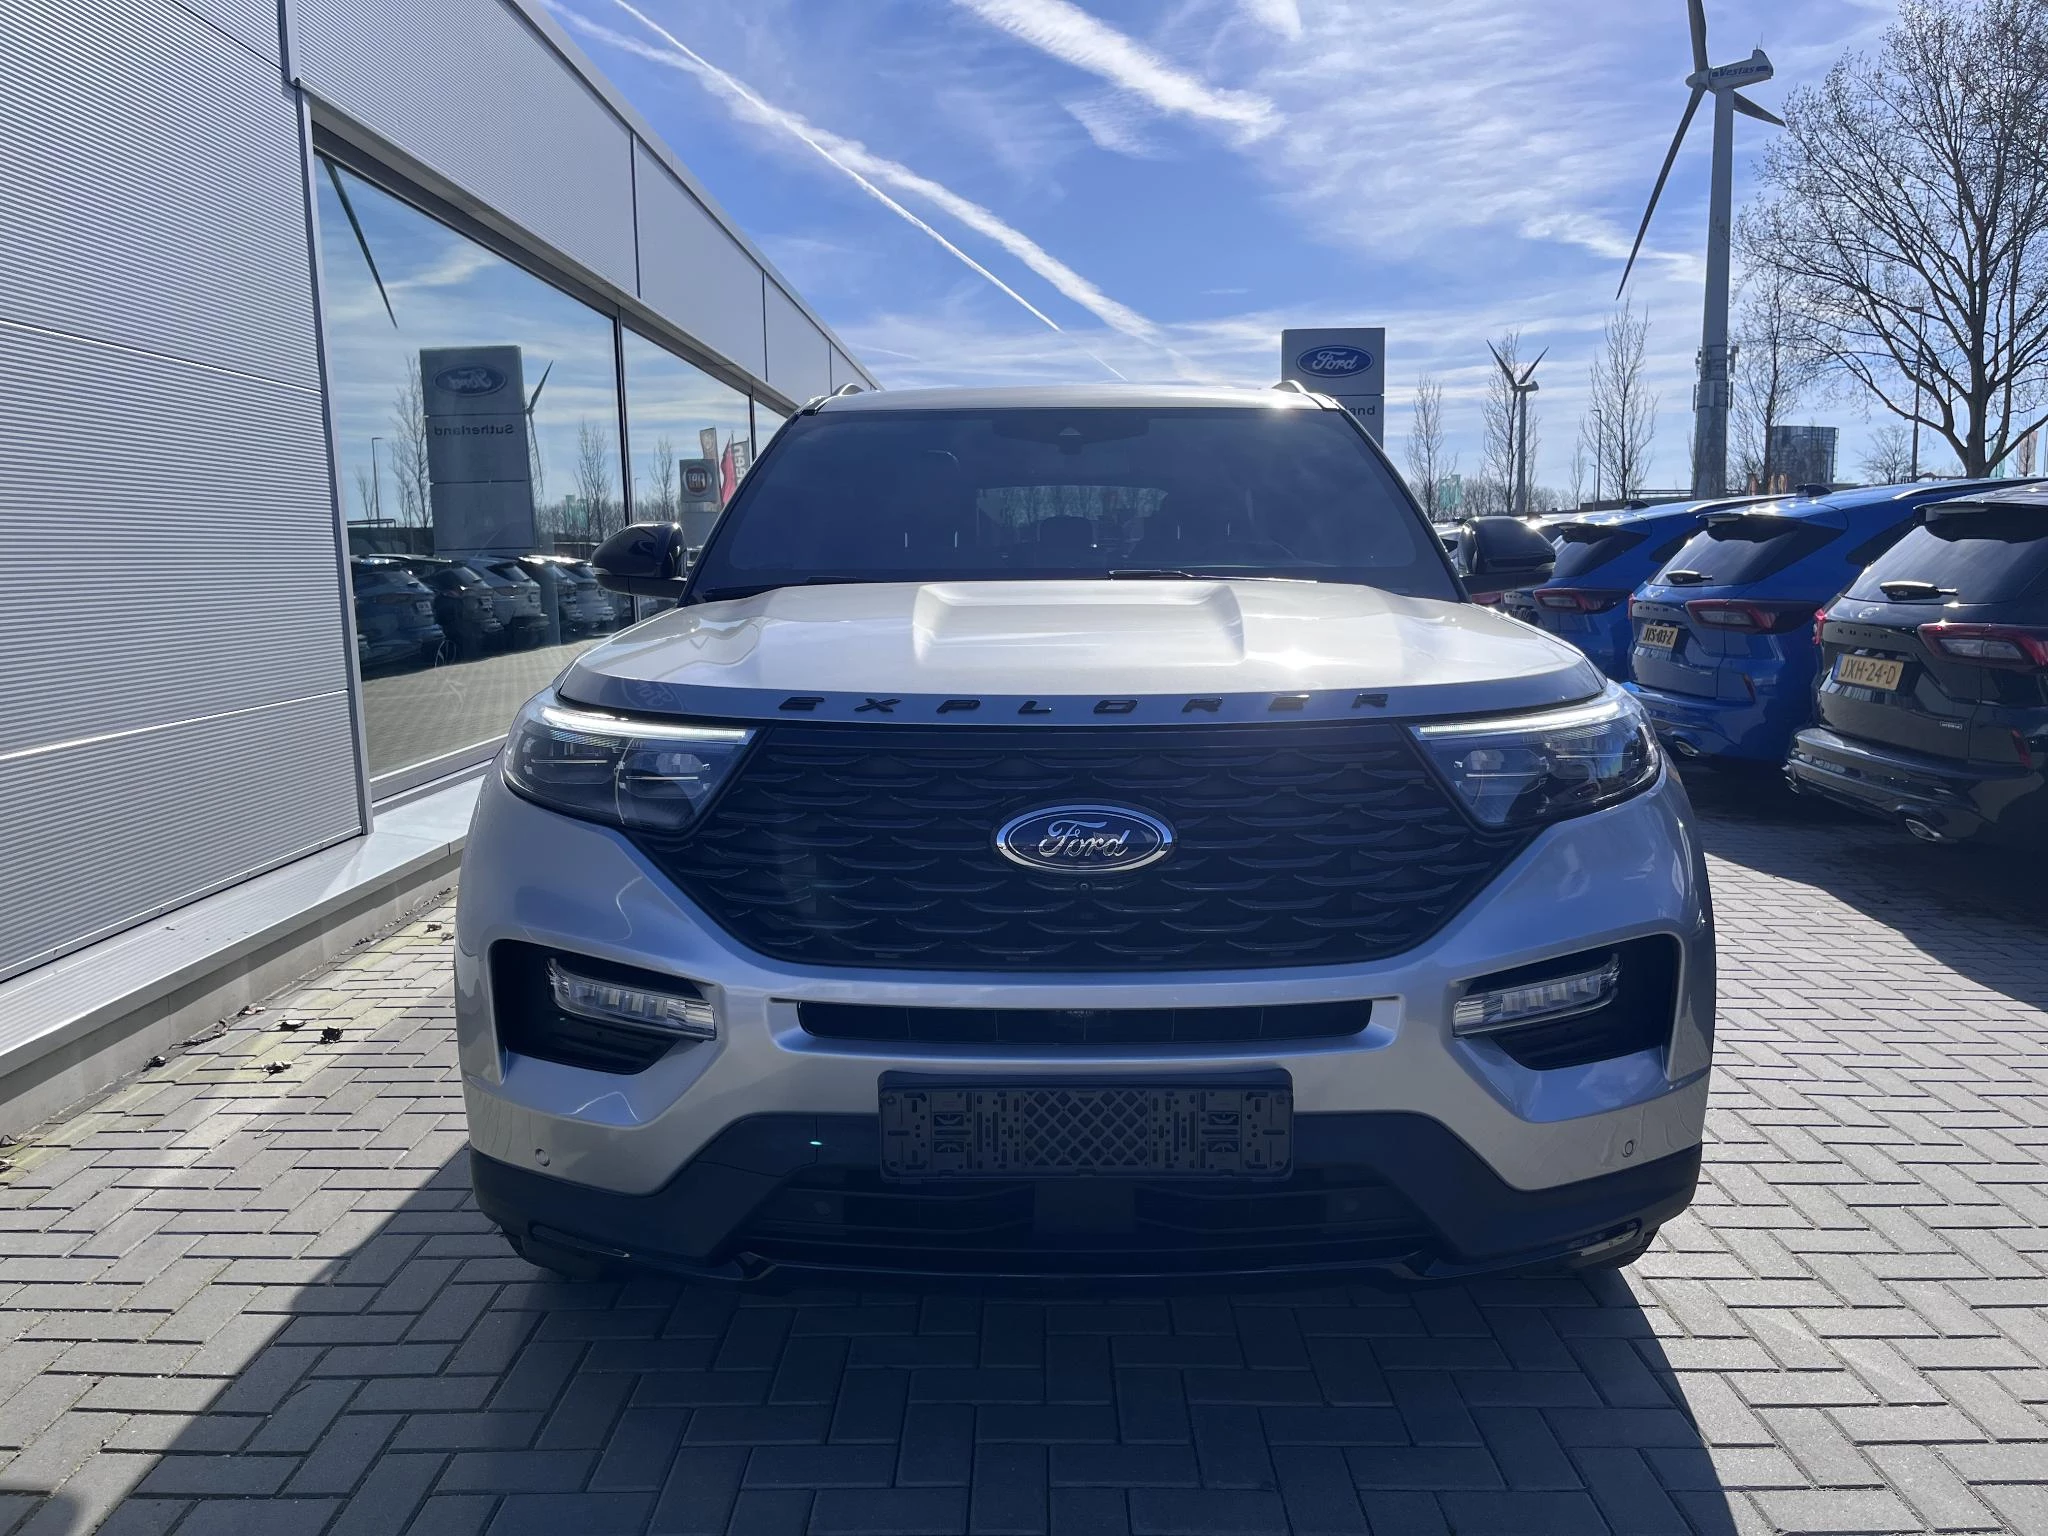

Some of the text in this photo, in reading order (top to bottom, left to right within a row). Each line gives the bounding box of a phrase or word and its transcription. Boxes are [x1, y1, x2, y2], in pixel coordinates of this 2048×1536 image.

[1720, 66, 1755, 77] Vestas
[1311, 350, 1359, 370] Ford
[777, 692, 1390, 715] EXPLORER
[1038, 819, 1131, 857] Ford
